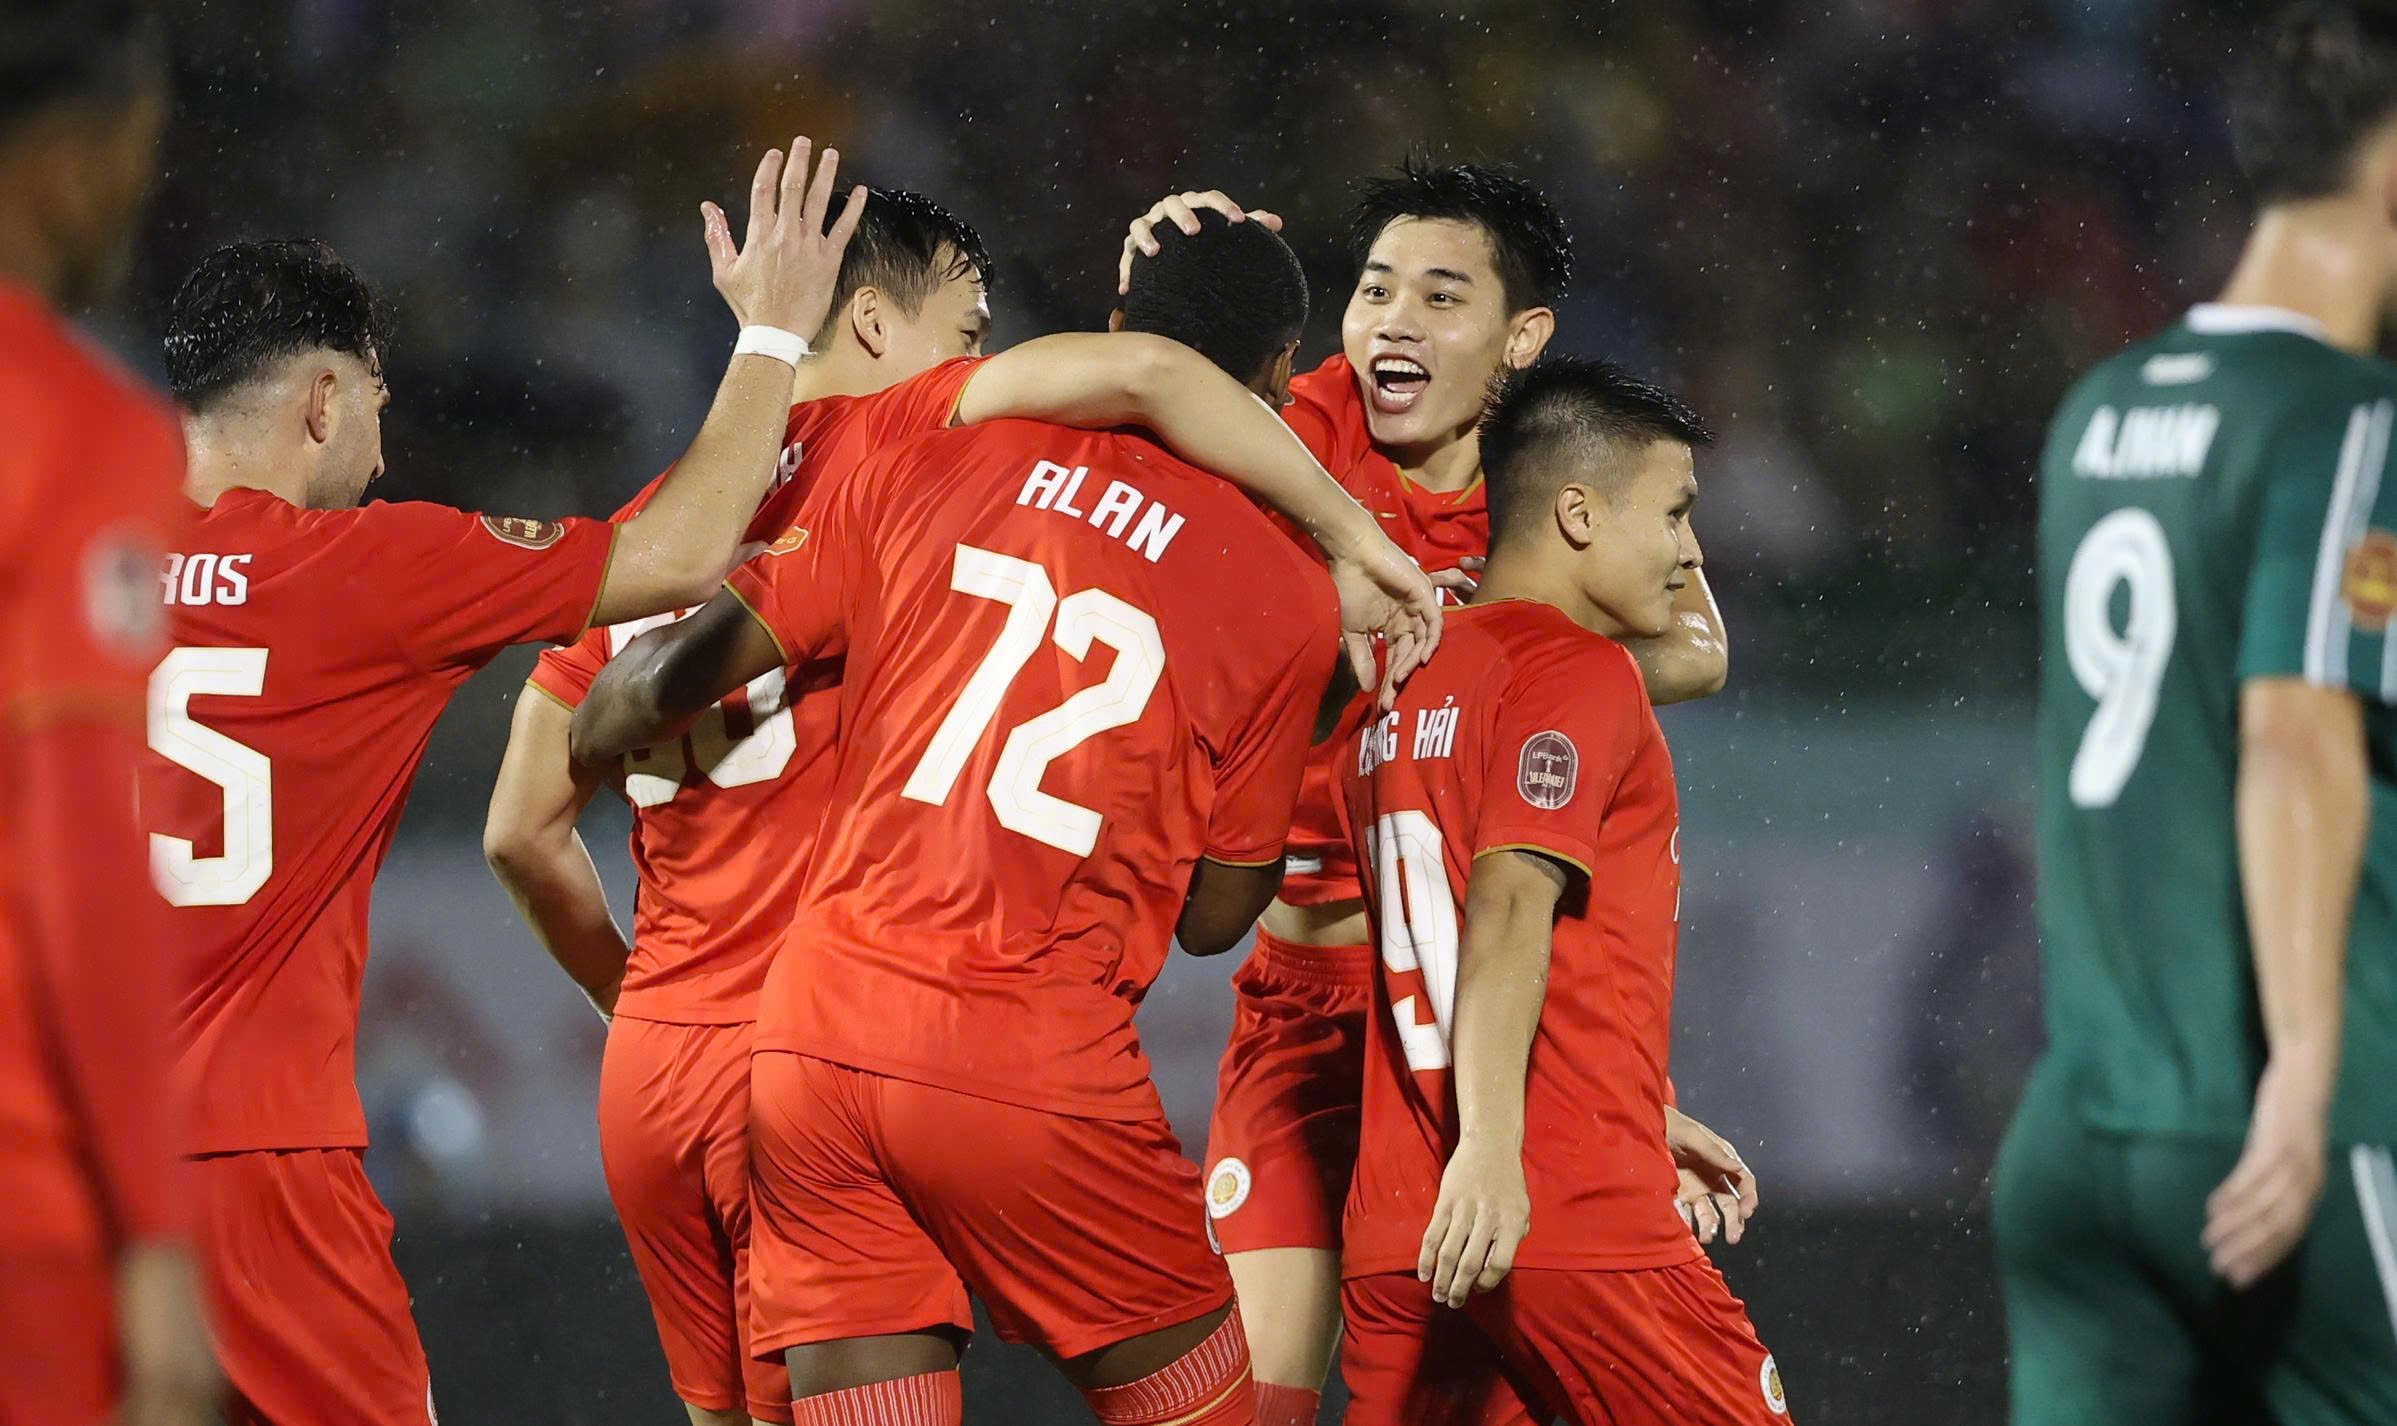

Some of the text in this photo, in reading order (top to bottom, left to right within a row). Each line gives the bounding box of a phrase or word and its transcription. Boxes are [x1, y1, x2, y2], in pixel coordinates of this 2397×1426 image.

[1015, 459, 1186, 563] ALAN
[147, 647, 273, 907] 5
[900, 542, 1167, 858] 72
[1412, 695, 1461, 760] HẢI
[2064, 507, 2178, 810] 9
